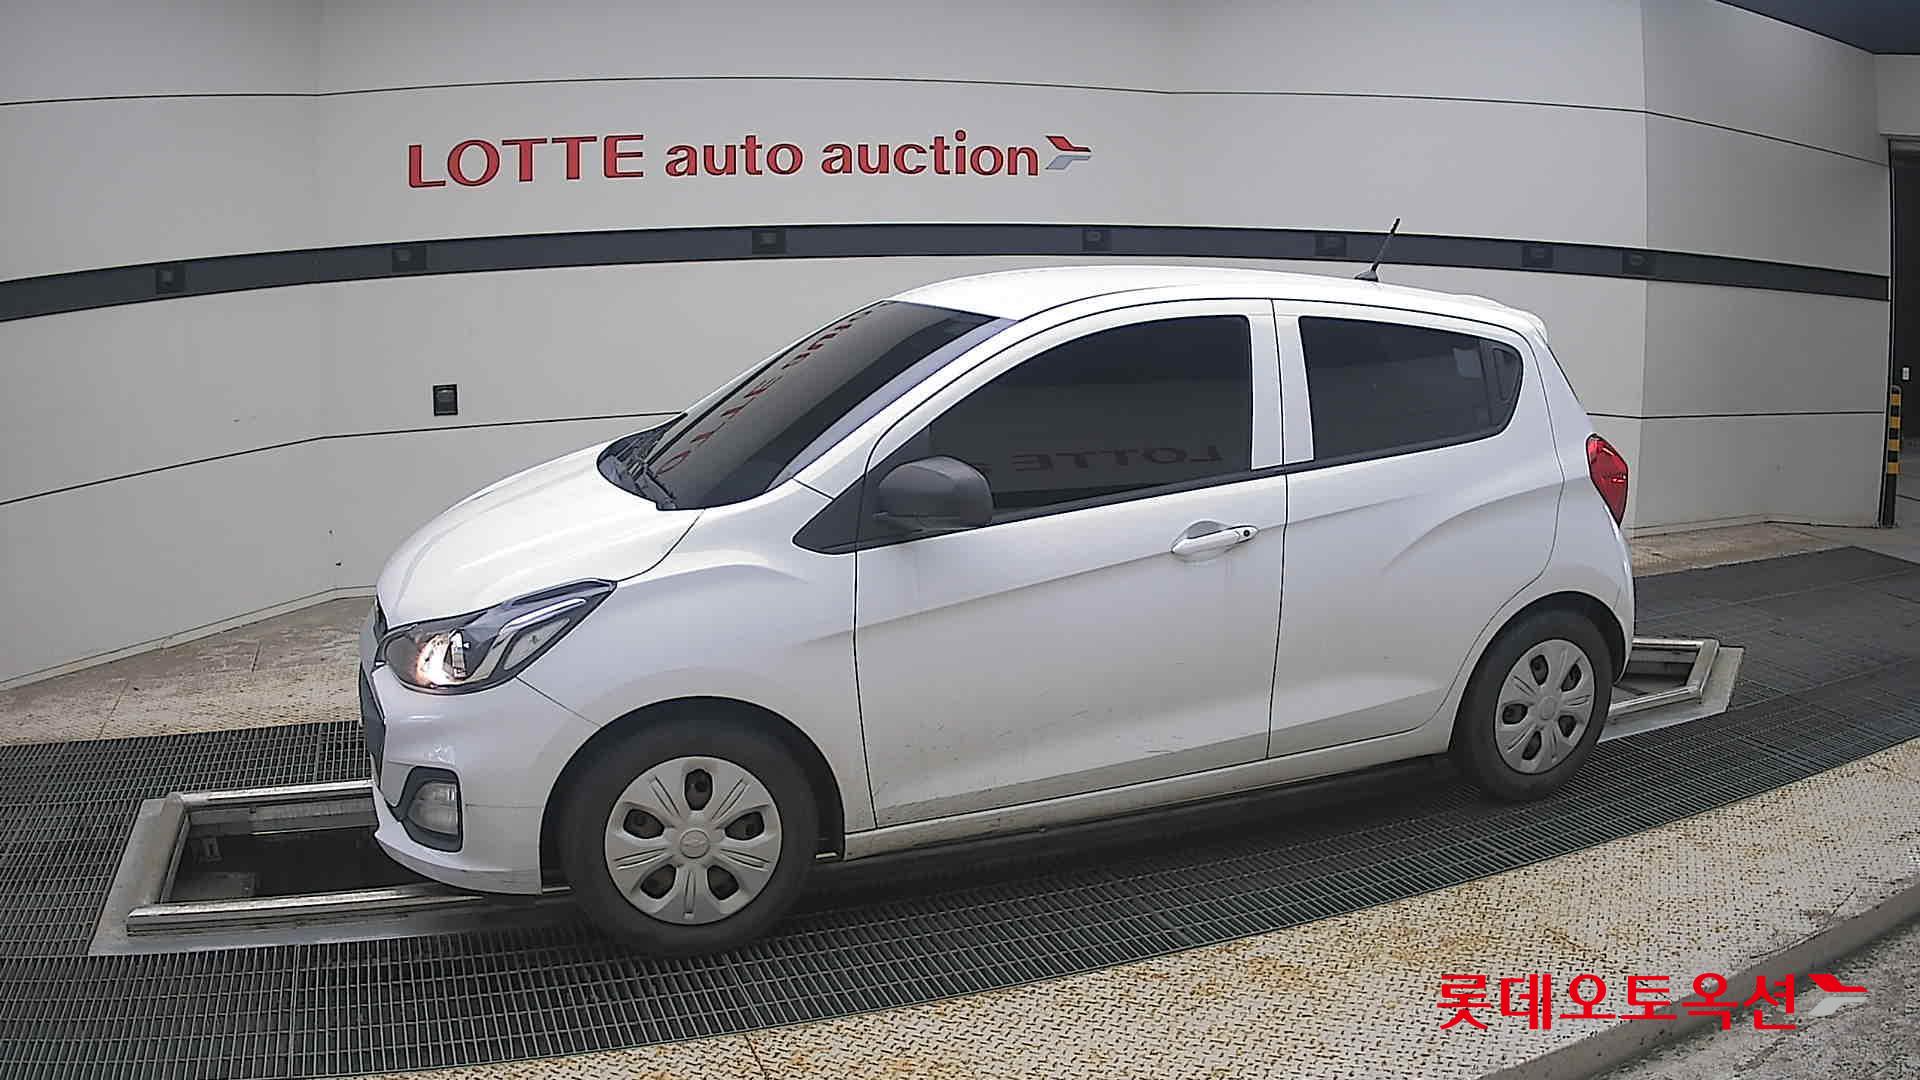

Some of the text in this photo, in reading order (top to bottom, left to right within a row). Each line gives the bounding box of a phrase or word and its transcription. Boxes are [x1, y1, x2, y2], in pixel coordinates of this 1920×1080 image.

[407, 129, 1040, 189] LOTTE auto auction
